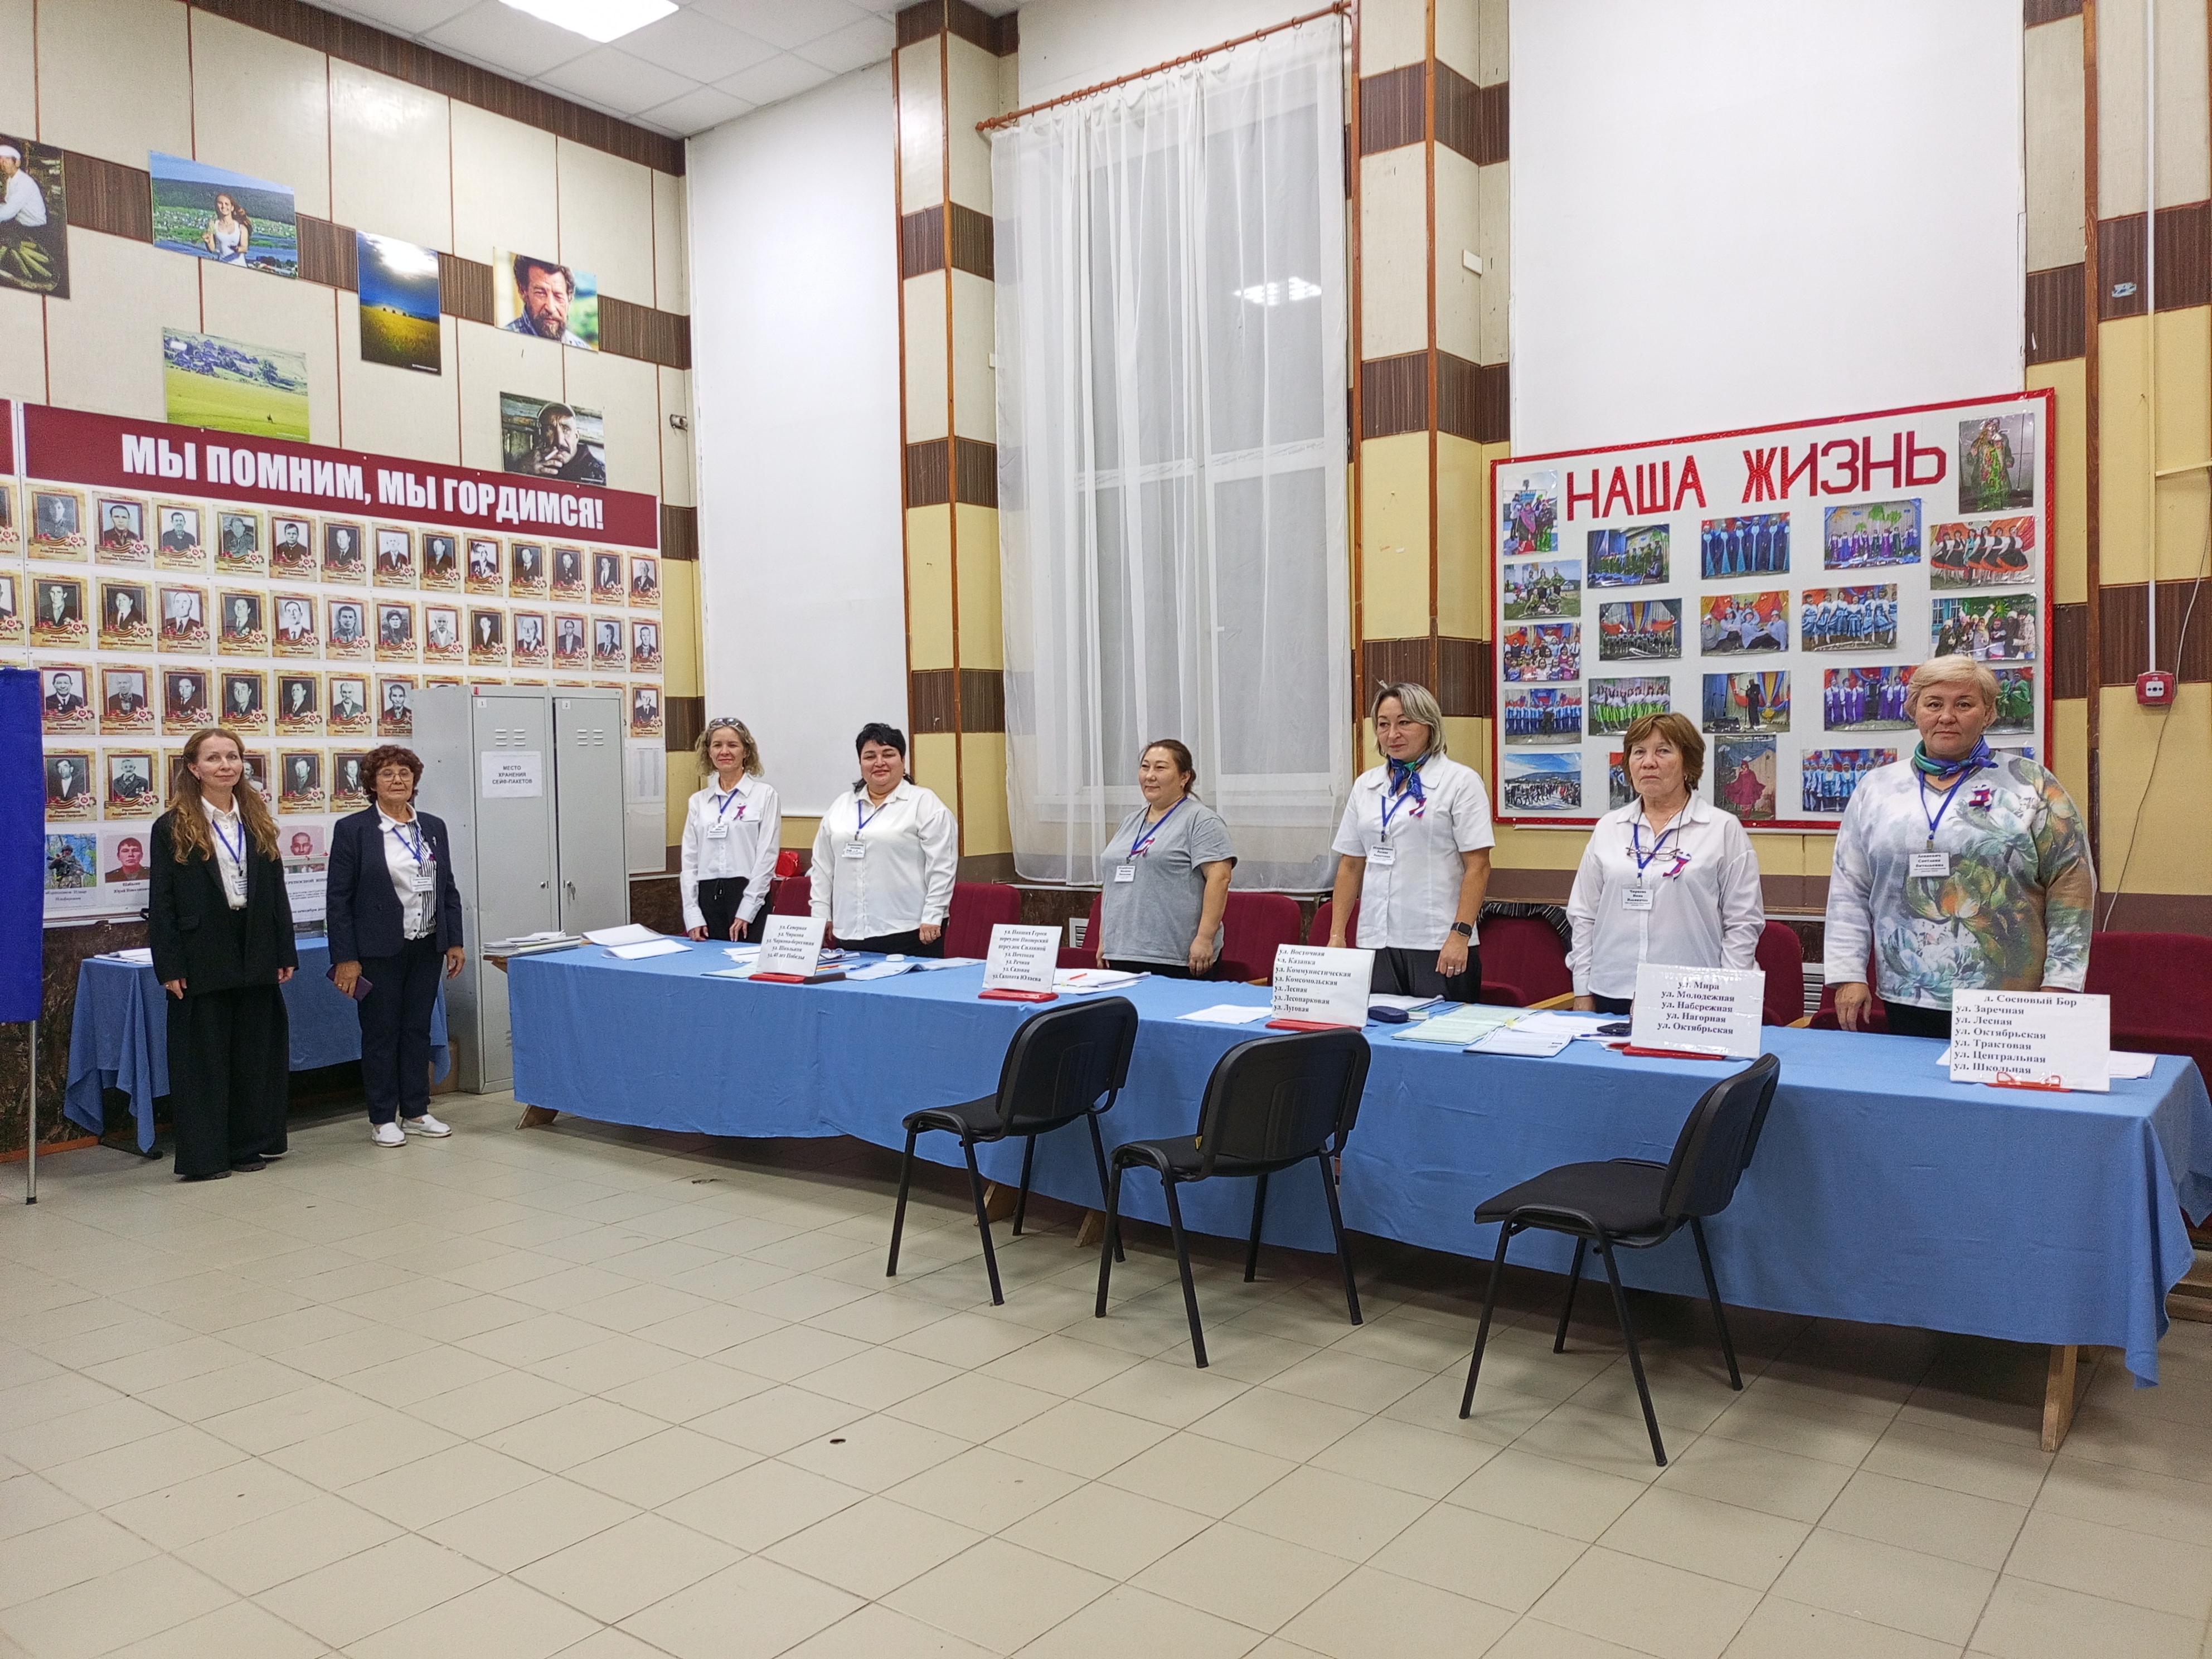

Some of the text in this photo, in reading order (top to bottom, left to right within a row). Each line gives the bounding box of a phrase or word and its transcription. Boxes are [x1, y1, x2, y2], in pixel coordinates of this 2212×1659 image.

[1567, 431, 1947, 521] НАША ЖИЗНЬ
[122, 434, 605, 530] МЫ ПОМНИМ, МЫ ГОРДИМСЯ!
[1286, 967, 1351, 977] Коммунистическая
[1286, 976, 1337, 986] Комсомольская
[1694, 981, 1719, 991] Мира
[1284, 995, 1330, 1005] Лесопарковая
[1677, 991, 1735, 1002] Молодежная
[1984, 995, 2077, 1008] д. Сосновый Бор
[1677, 1002, 1733, 1012] Набережная
[1956, 1005, 2024, 1015] ул. Заречная
[1682, 1012, 1726, 1023] Нагорная
[1955, 1016, 2012, 1026] ул. Лесная
[1657, 1022, 1733, 1035] ул. Октябрьская
[1955, 1027, 2046, 1040] ул. Октябрьская
[1954, 1039, 2031, 1050] ул. Трактовая
[1954, 1051, 2046, 1063] ул. Центральная
[1954, 1063, 2031, 1074] ул. Школьная
